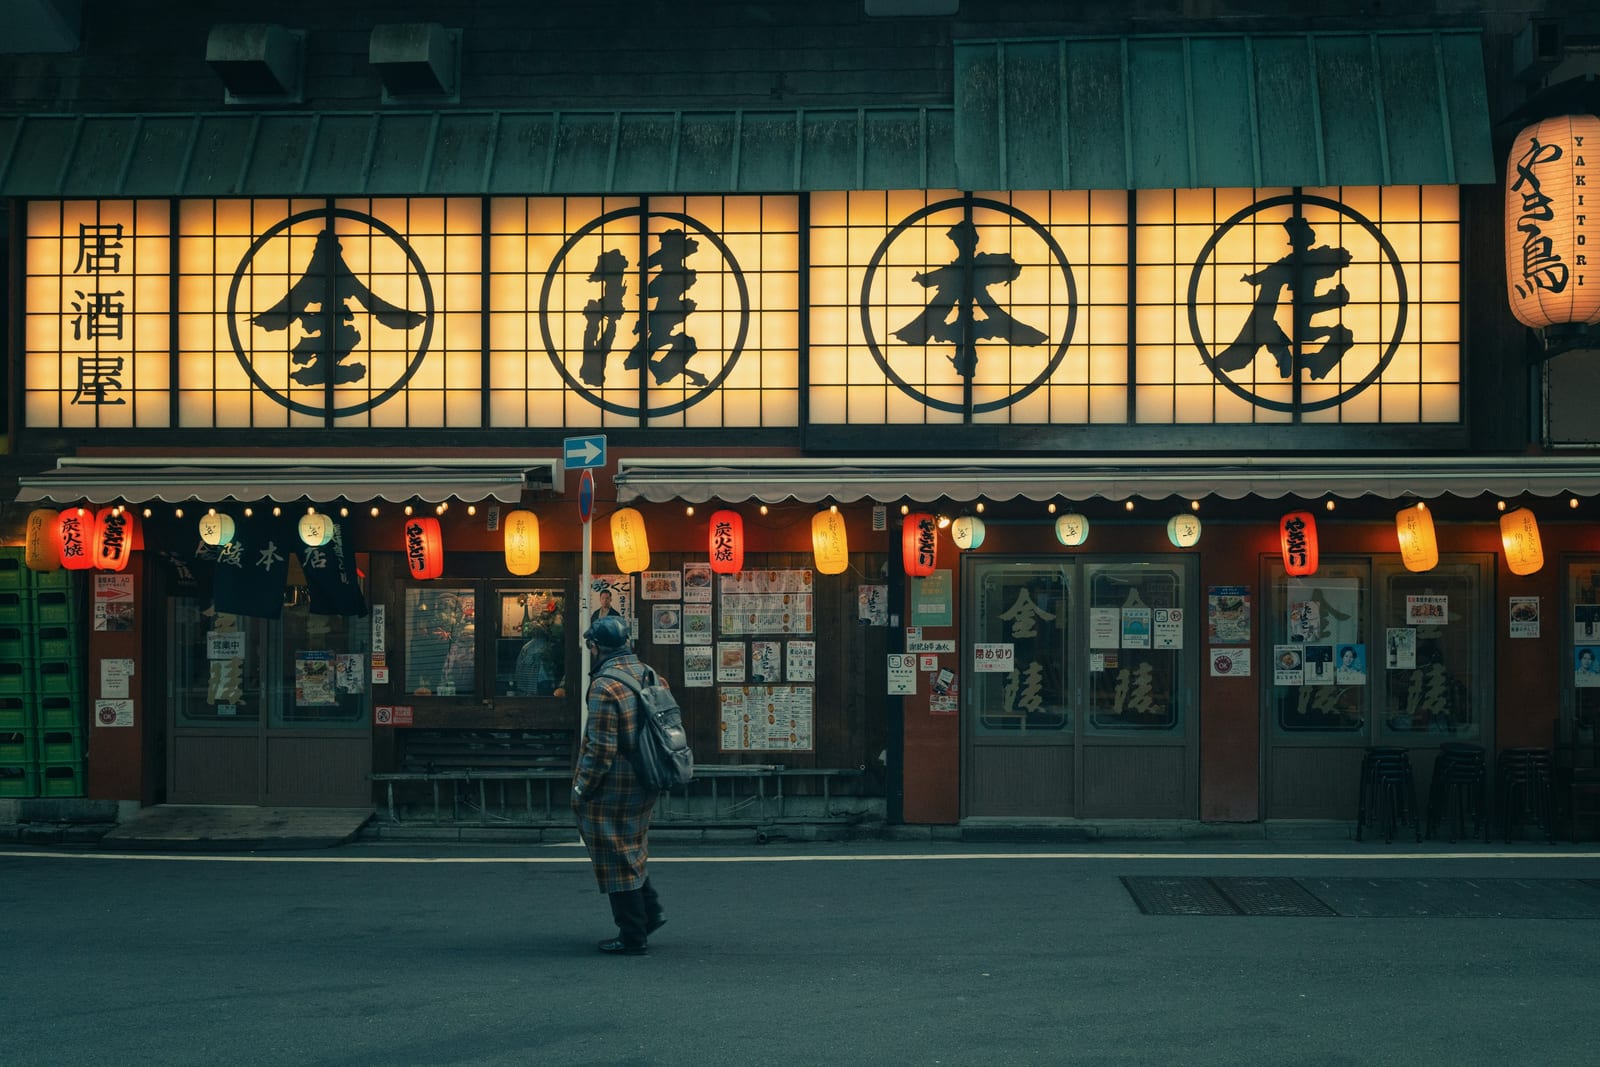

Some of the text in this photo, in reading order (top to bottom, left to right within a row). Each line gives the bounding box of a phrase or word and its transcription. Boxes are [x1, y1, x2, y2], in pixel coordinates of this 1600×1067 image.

[1510, 137, 1569, 299] やき鳥
[1574, 136, 1587, 286] YAKITORI
[70, 222, 126, 406] 居酒屋
[62, 518, 84, 558] 炭火焼
[406, 523, 425, 571] やきとり
[714, 522, 734, 562] 炭火焼
[918, 519, 936, 569] やきとり
[1285, 517, 1306, 567] やきとり
